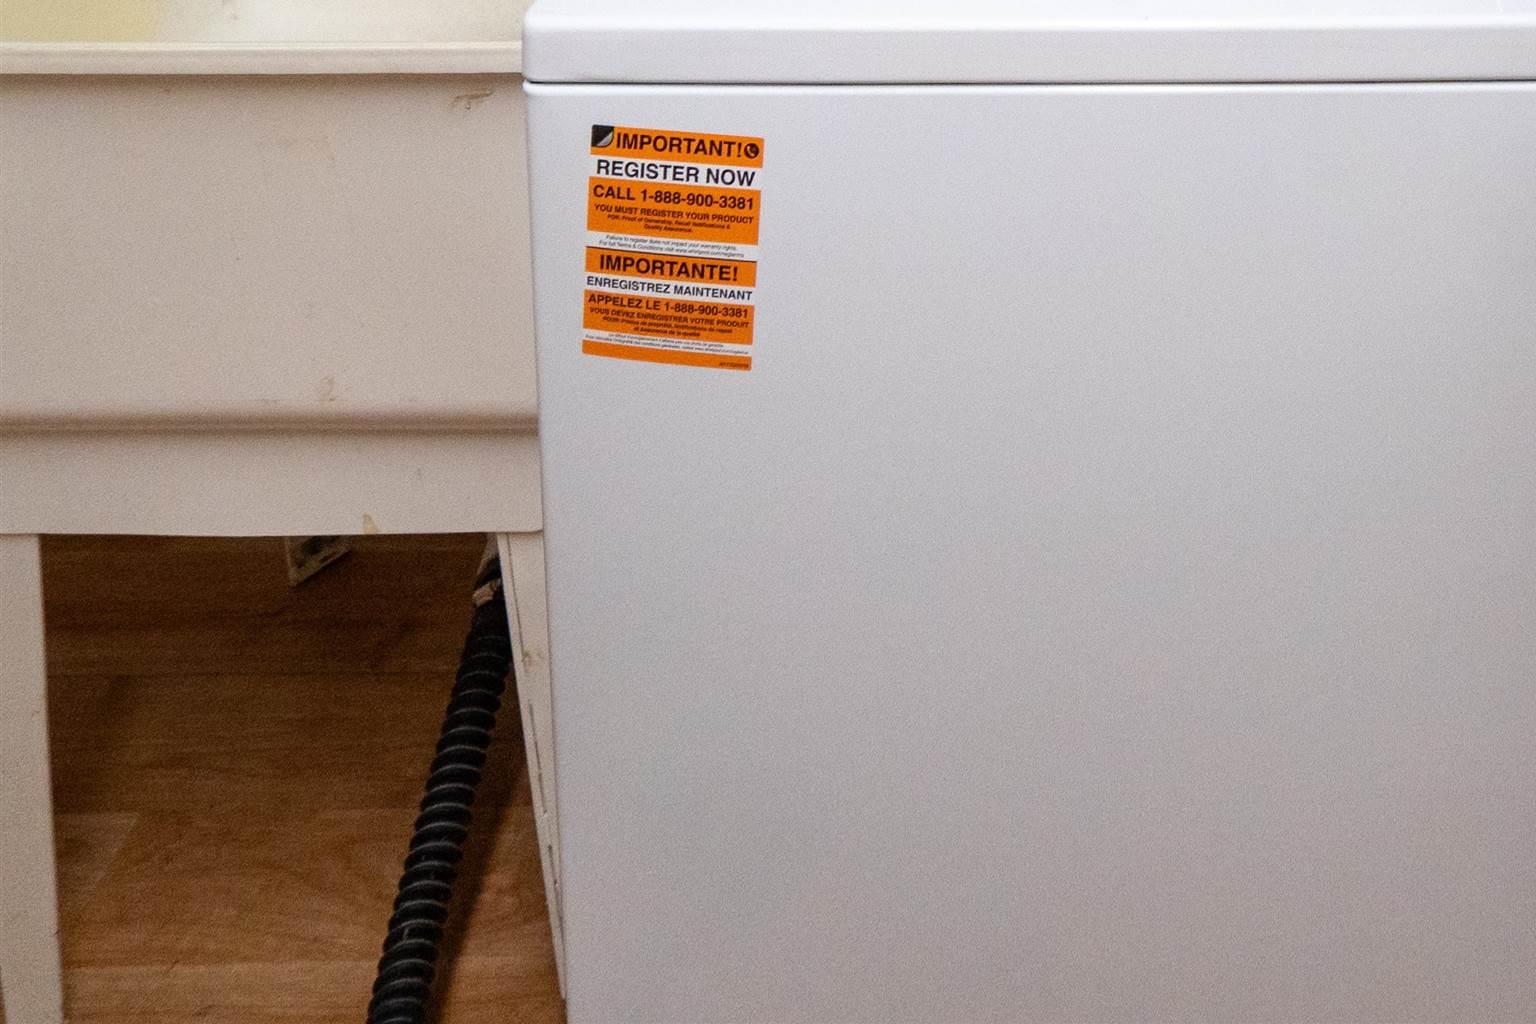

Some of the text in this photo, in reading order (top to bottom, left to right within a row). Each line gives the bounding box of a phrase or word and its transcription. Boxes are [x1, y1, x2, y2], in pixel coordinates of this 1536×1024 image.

[616, 132, 742, 158] IMPORTANT!
[596, 159, 756, 187] REGISTER NOW
[593, 184, 754, 210] CALL 1-888-900-3381
[594, 203, 753, 224] YOU MUST REGISTER YOUR PRODUCT
[644, 224, 663, 232] Quality
[600, 254, 738, 282] IMPORTANTE!
[586, 276, 753, 301] ENREGISTREZ MAINTENANT
[588, 293, 749, 319] APPELEZ LE 1-888-900-3381
[590, 307, 610, 315] VOUS
[611, 310, 635, 319] DEVEZ
[690, 317, 715, 325] VOTRE
[716, 319, 749, 328] PRODUIT
